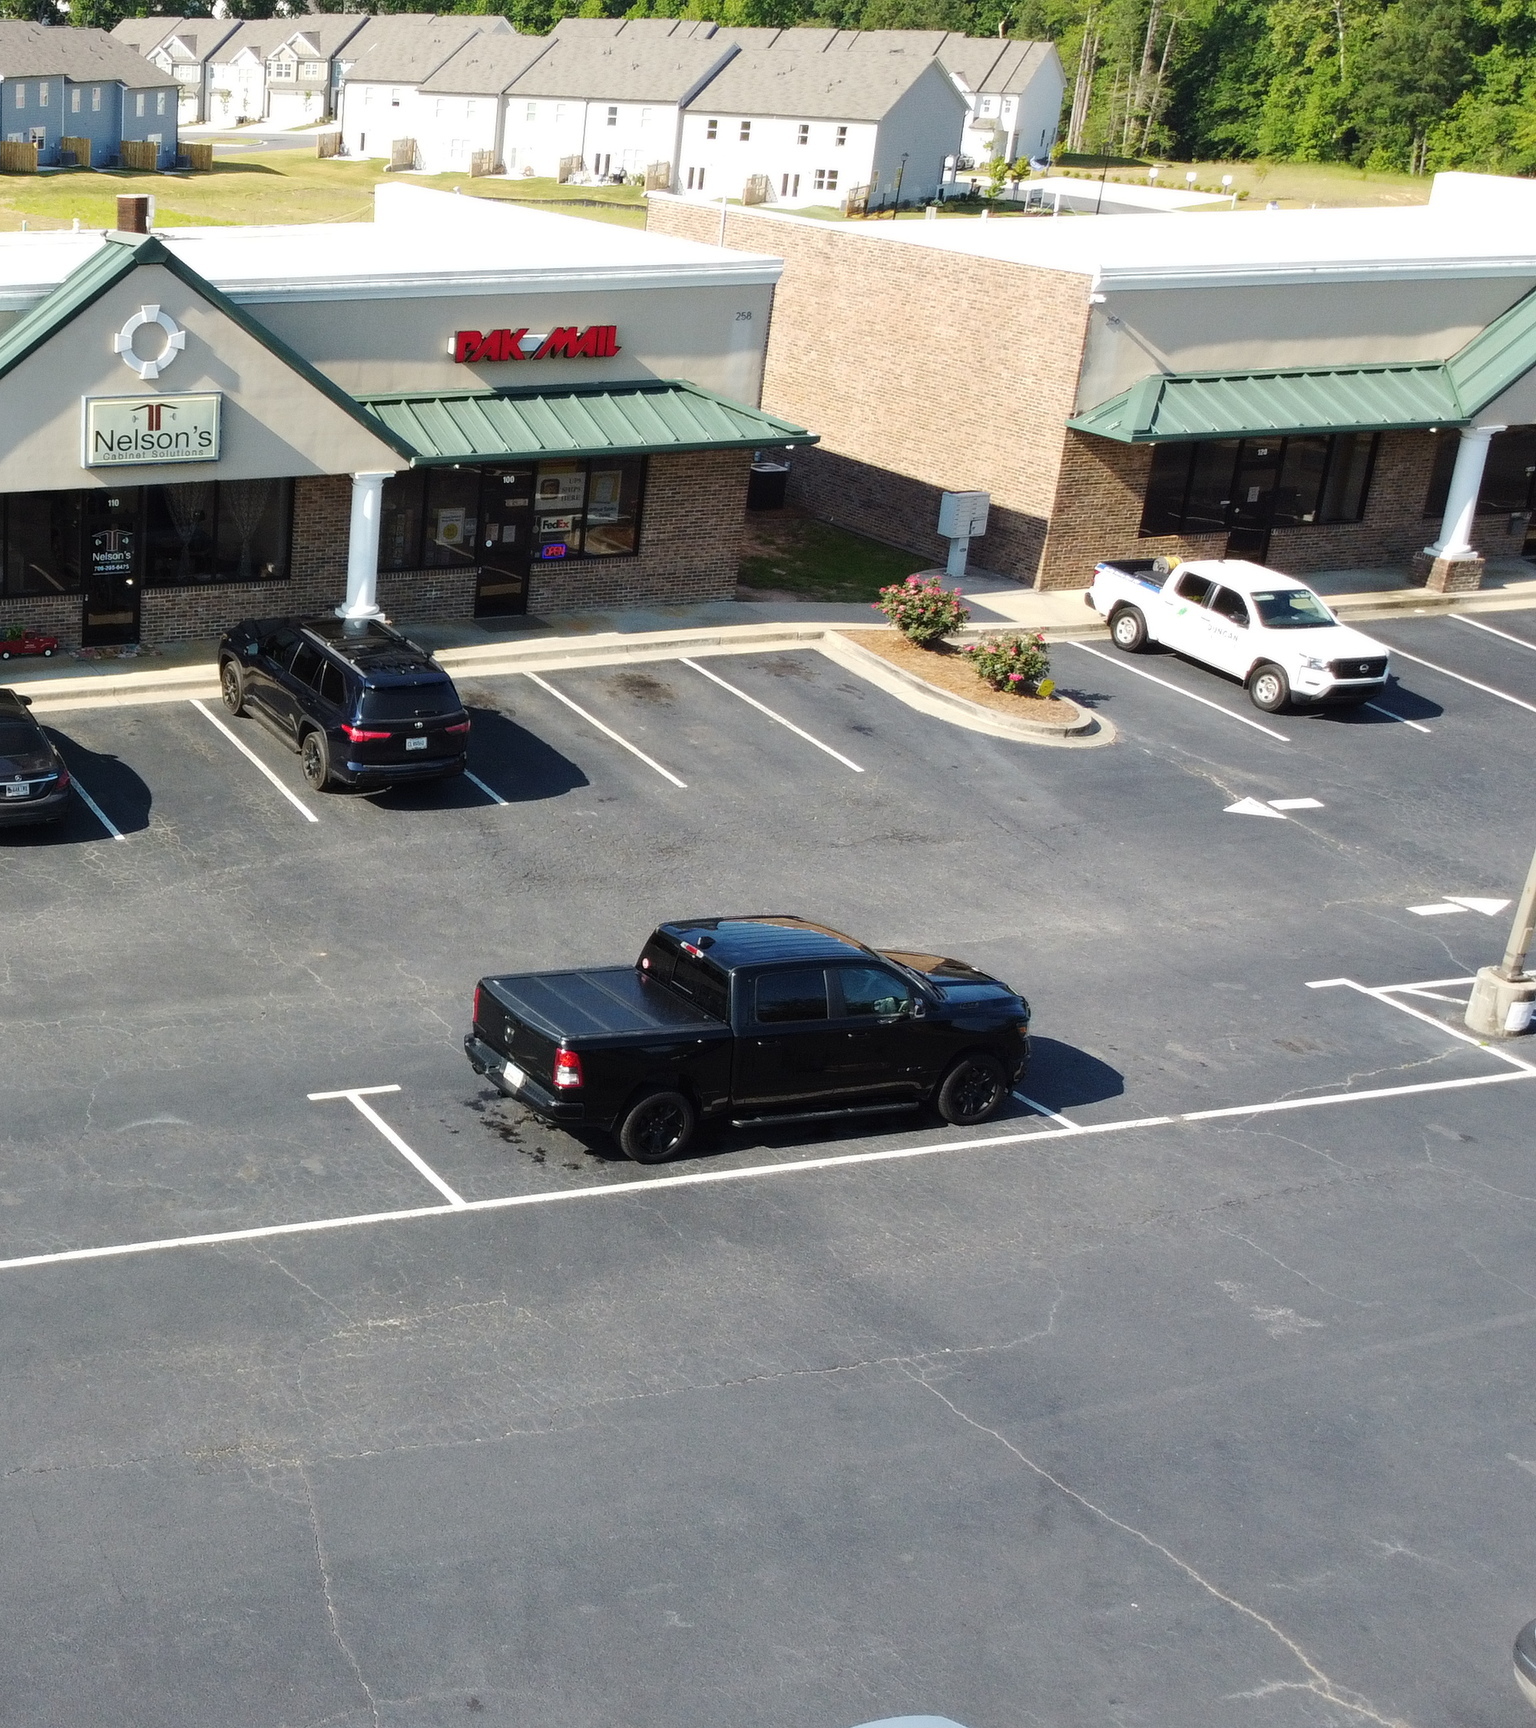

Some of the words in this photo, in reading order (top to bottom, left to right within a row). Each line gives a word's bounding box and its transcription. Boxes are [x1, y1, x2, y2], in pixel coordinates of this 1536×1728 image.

[735, 311, 752, 321] 258
[454, 328, 530, 363] PAK
[530, 325, 622, 360] MAIL
[94, 426, 212, 452] Nelson's
[103, 451, 146, 461] Cabinet
[152, 449, 204, 458] Solutions
[503, 475, 515, 484] 100
[108, 499, 120, 507] 110
[543, 519, 570, 530] FedEx
[92, 551, 132, 562] Nelson's
[544, 546, 565, 557] OPEN
